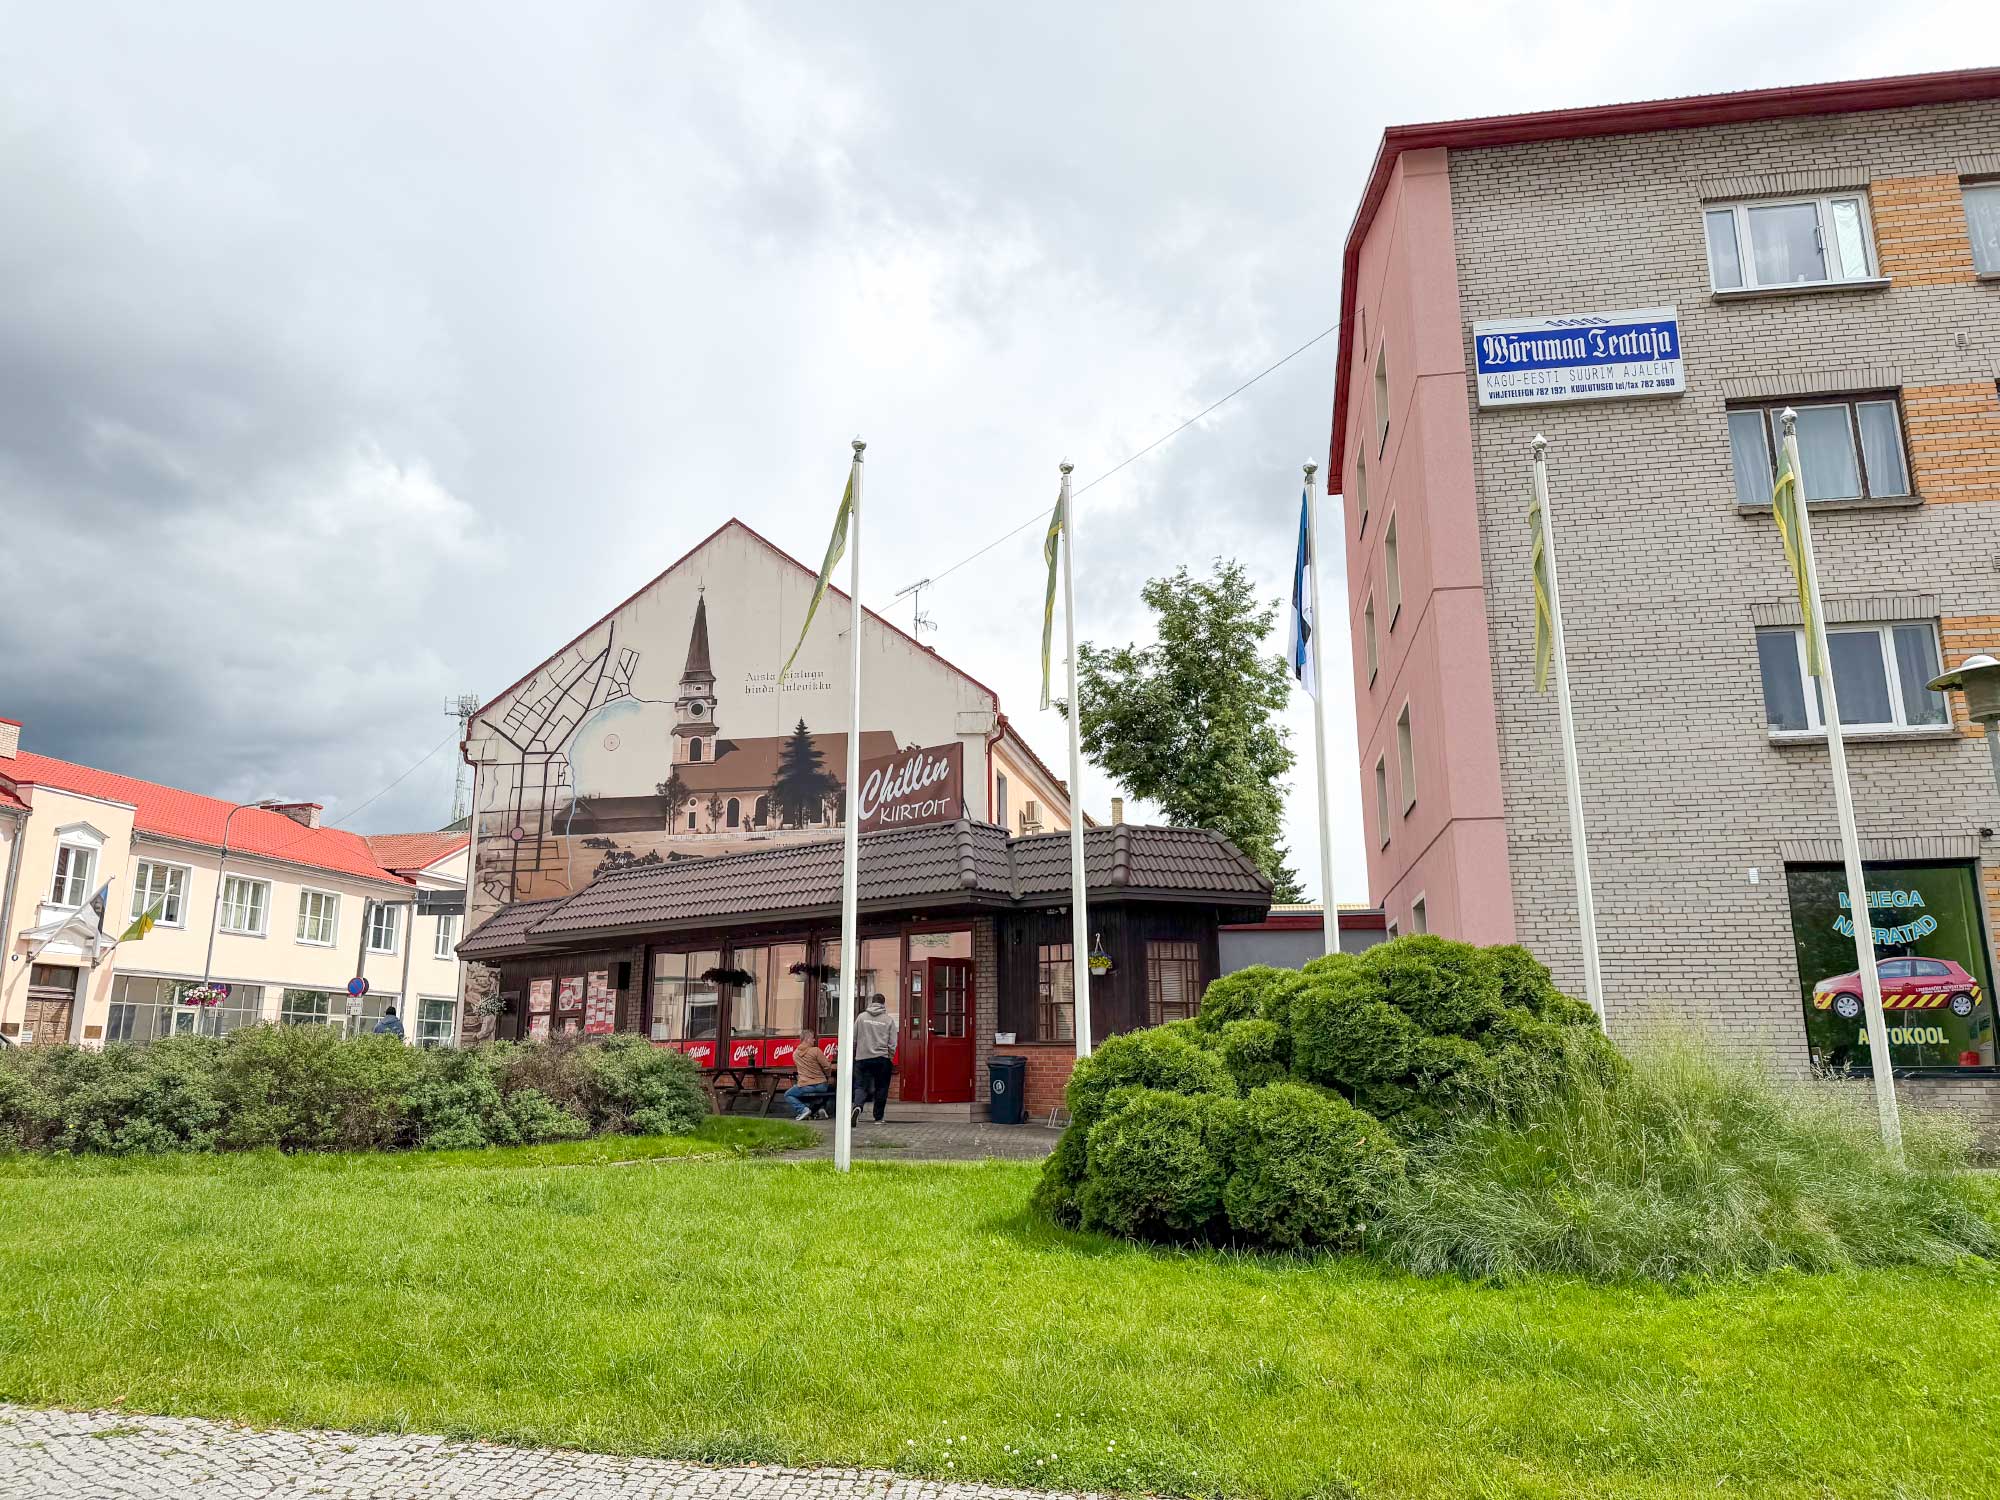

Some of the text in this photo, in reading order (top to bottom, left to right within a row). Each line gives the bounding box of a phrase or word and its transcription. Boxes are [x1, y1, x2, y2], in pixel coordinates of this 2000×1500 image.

[1483, 328, 1673, 365] Wõrumaa Teataja
[1486, 361, 1676, 388] KAGU-EESTI SUURIM AJALEHT
[1488, 388, 1534, 399] VIHJETELEFON
[1551, 386, 1567, 395] 1921
[1571, 383, 1614, 393] KUULUTUSED
[859, 753, 950, 820] Chillin
[880, 797, 951, 825] KIIRTOIT
[1832, 914, 1938, 945] NRATAD
[1857, 1026, 1950, 1045] AOKOOL
